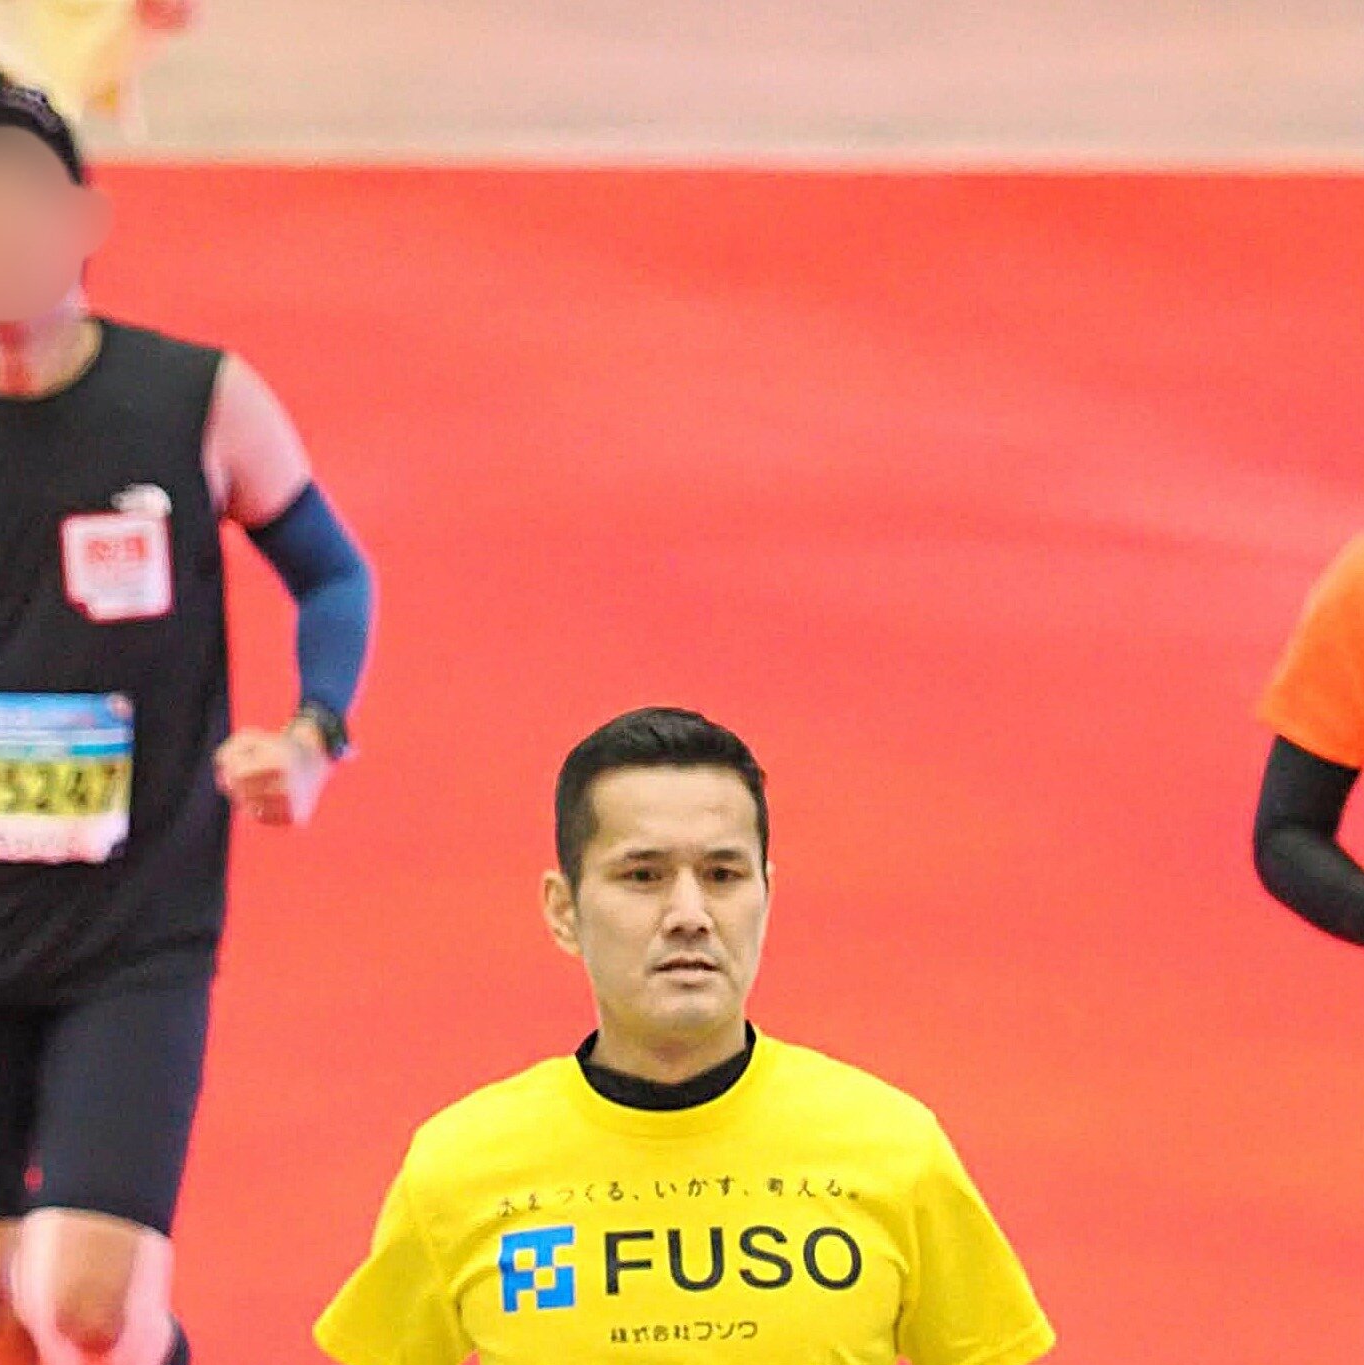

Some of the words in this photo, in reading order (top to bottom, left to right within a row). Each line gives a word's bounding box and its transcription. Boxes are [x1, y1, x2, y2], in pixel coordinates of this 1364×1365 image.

[603, 1226, 863, 1296] FUSO
[611, 1320, 759, 1344] 株式会社フソウ
